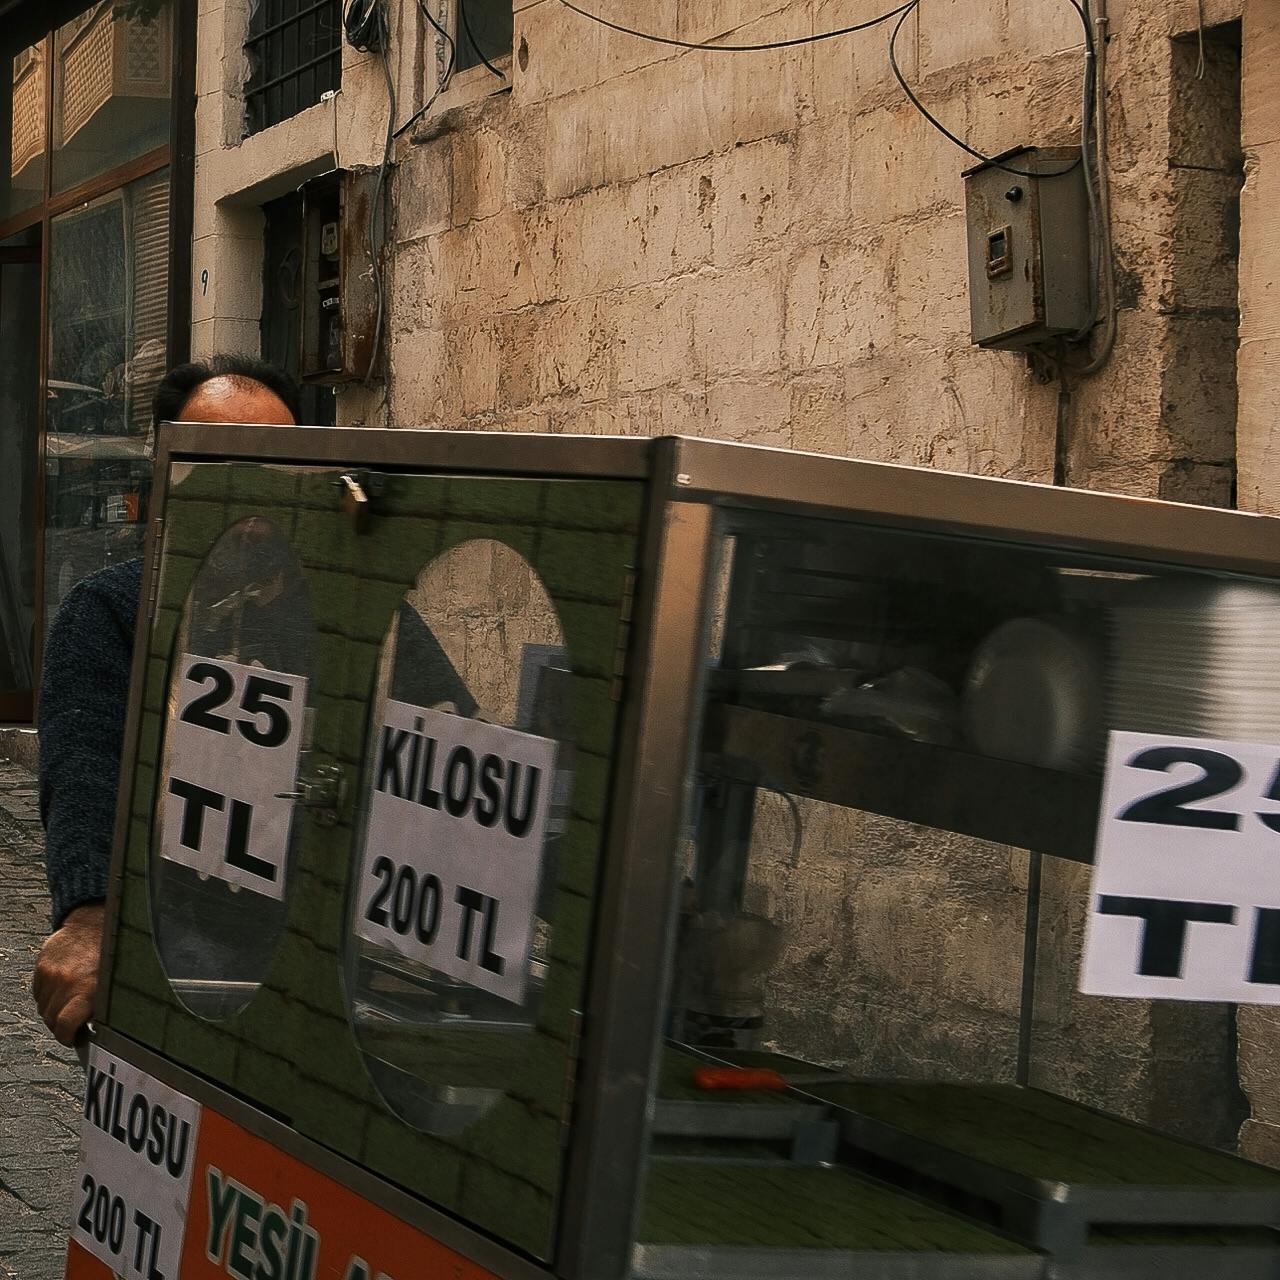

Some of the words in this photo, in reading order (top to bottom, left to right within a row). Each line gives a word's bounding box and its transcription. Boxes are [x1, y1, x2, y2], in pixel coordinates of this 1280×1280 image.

[181, 661, 292, 748] 25
[374, 720, 541, 839] KİLOSU
[1115, 745, 1280, 834] 2
[169, 779, 277, 882] TL
[365, 855, 442, 945] 200
[453, 884, 506, 975] TL
[1095, 893, 1280, 986] T
[85, 1062, 191, 1179] KİLOSU
[78, 1173, 126, 1255] 200
